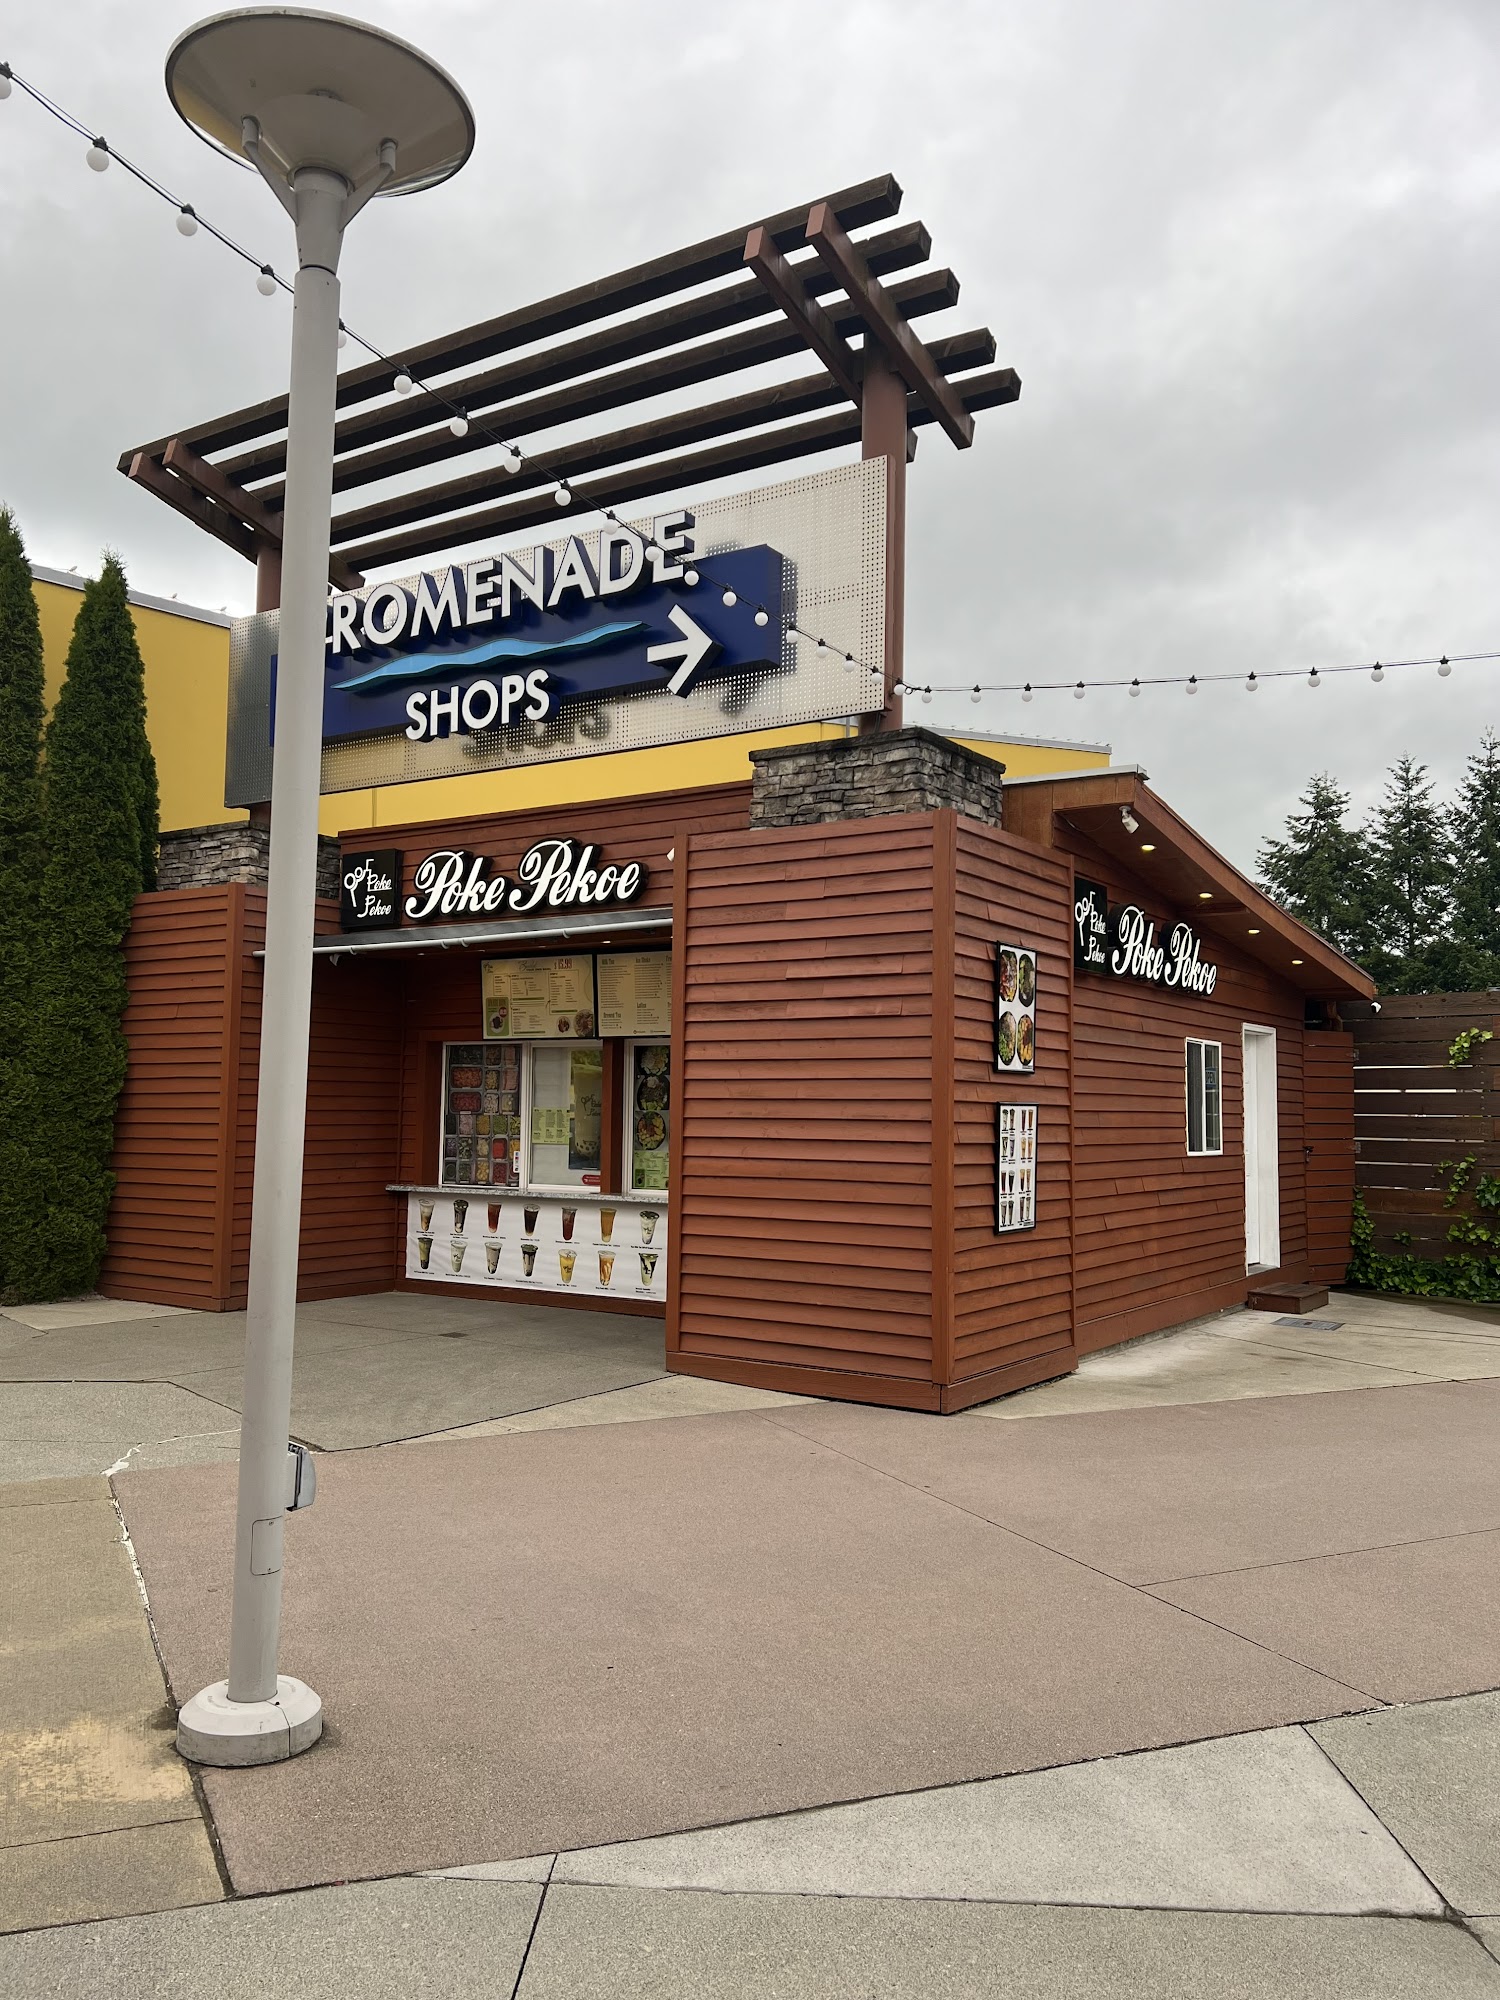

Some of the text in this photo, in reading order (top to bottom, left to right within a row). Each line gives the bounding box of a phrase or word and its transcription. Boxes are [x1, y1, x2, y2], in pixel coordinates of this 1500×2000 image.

[325, 509, 688, 654] ROMENADE
[405, 668, 550, 741] SHOPS
[366, 873, 392, 892] Poke
[404, 839, 640, 918] Poke Pekoe
[357, 895, 391, 918] Pekoe
[1090, 911, 1106, 934] Poke
[1084, 935, 1106, 963] Pekoe
[1111, 905, 1217, 994] Poke Pekoe
